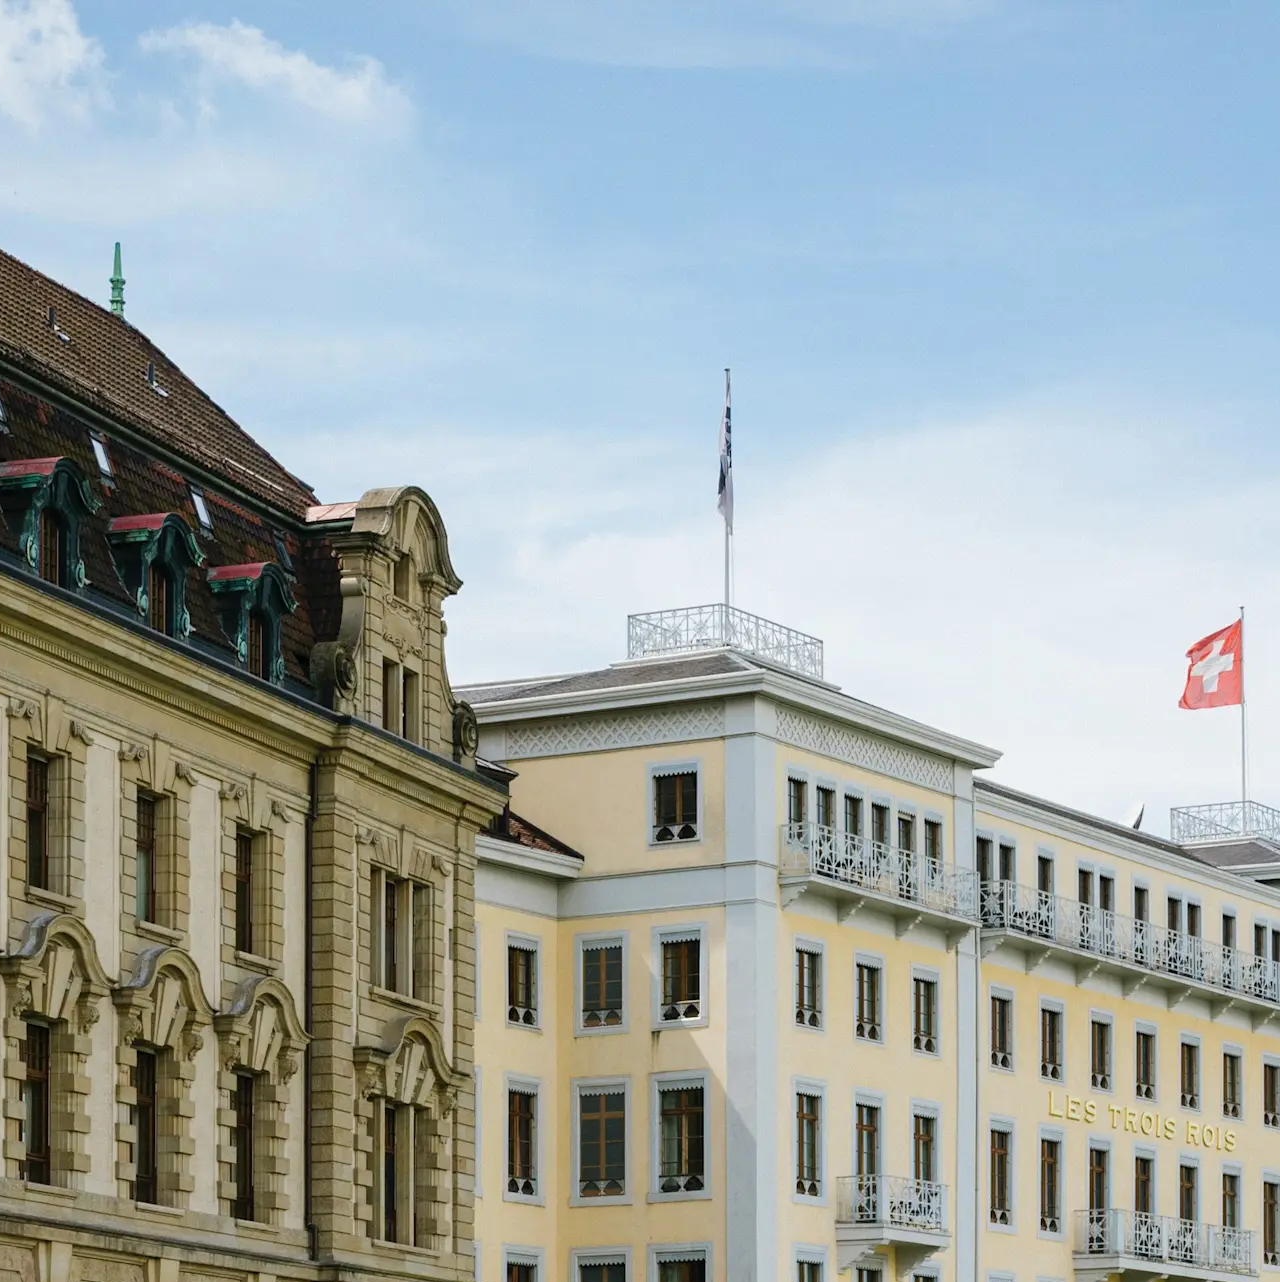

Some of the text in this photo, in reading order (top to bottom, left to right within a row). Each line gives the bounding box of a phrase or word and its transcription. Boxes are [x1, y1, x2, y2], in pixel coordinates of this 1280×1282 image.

[1048, 1090, 1237, 1152] LES TROIS ROIS
